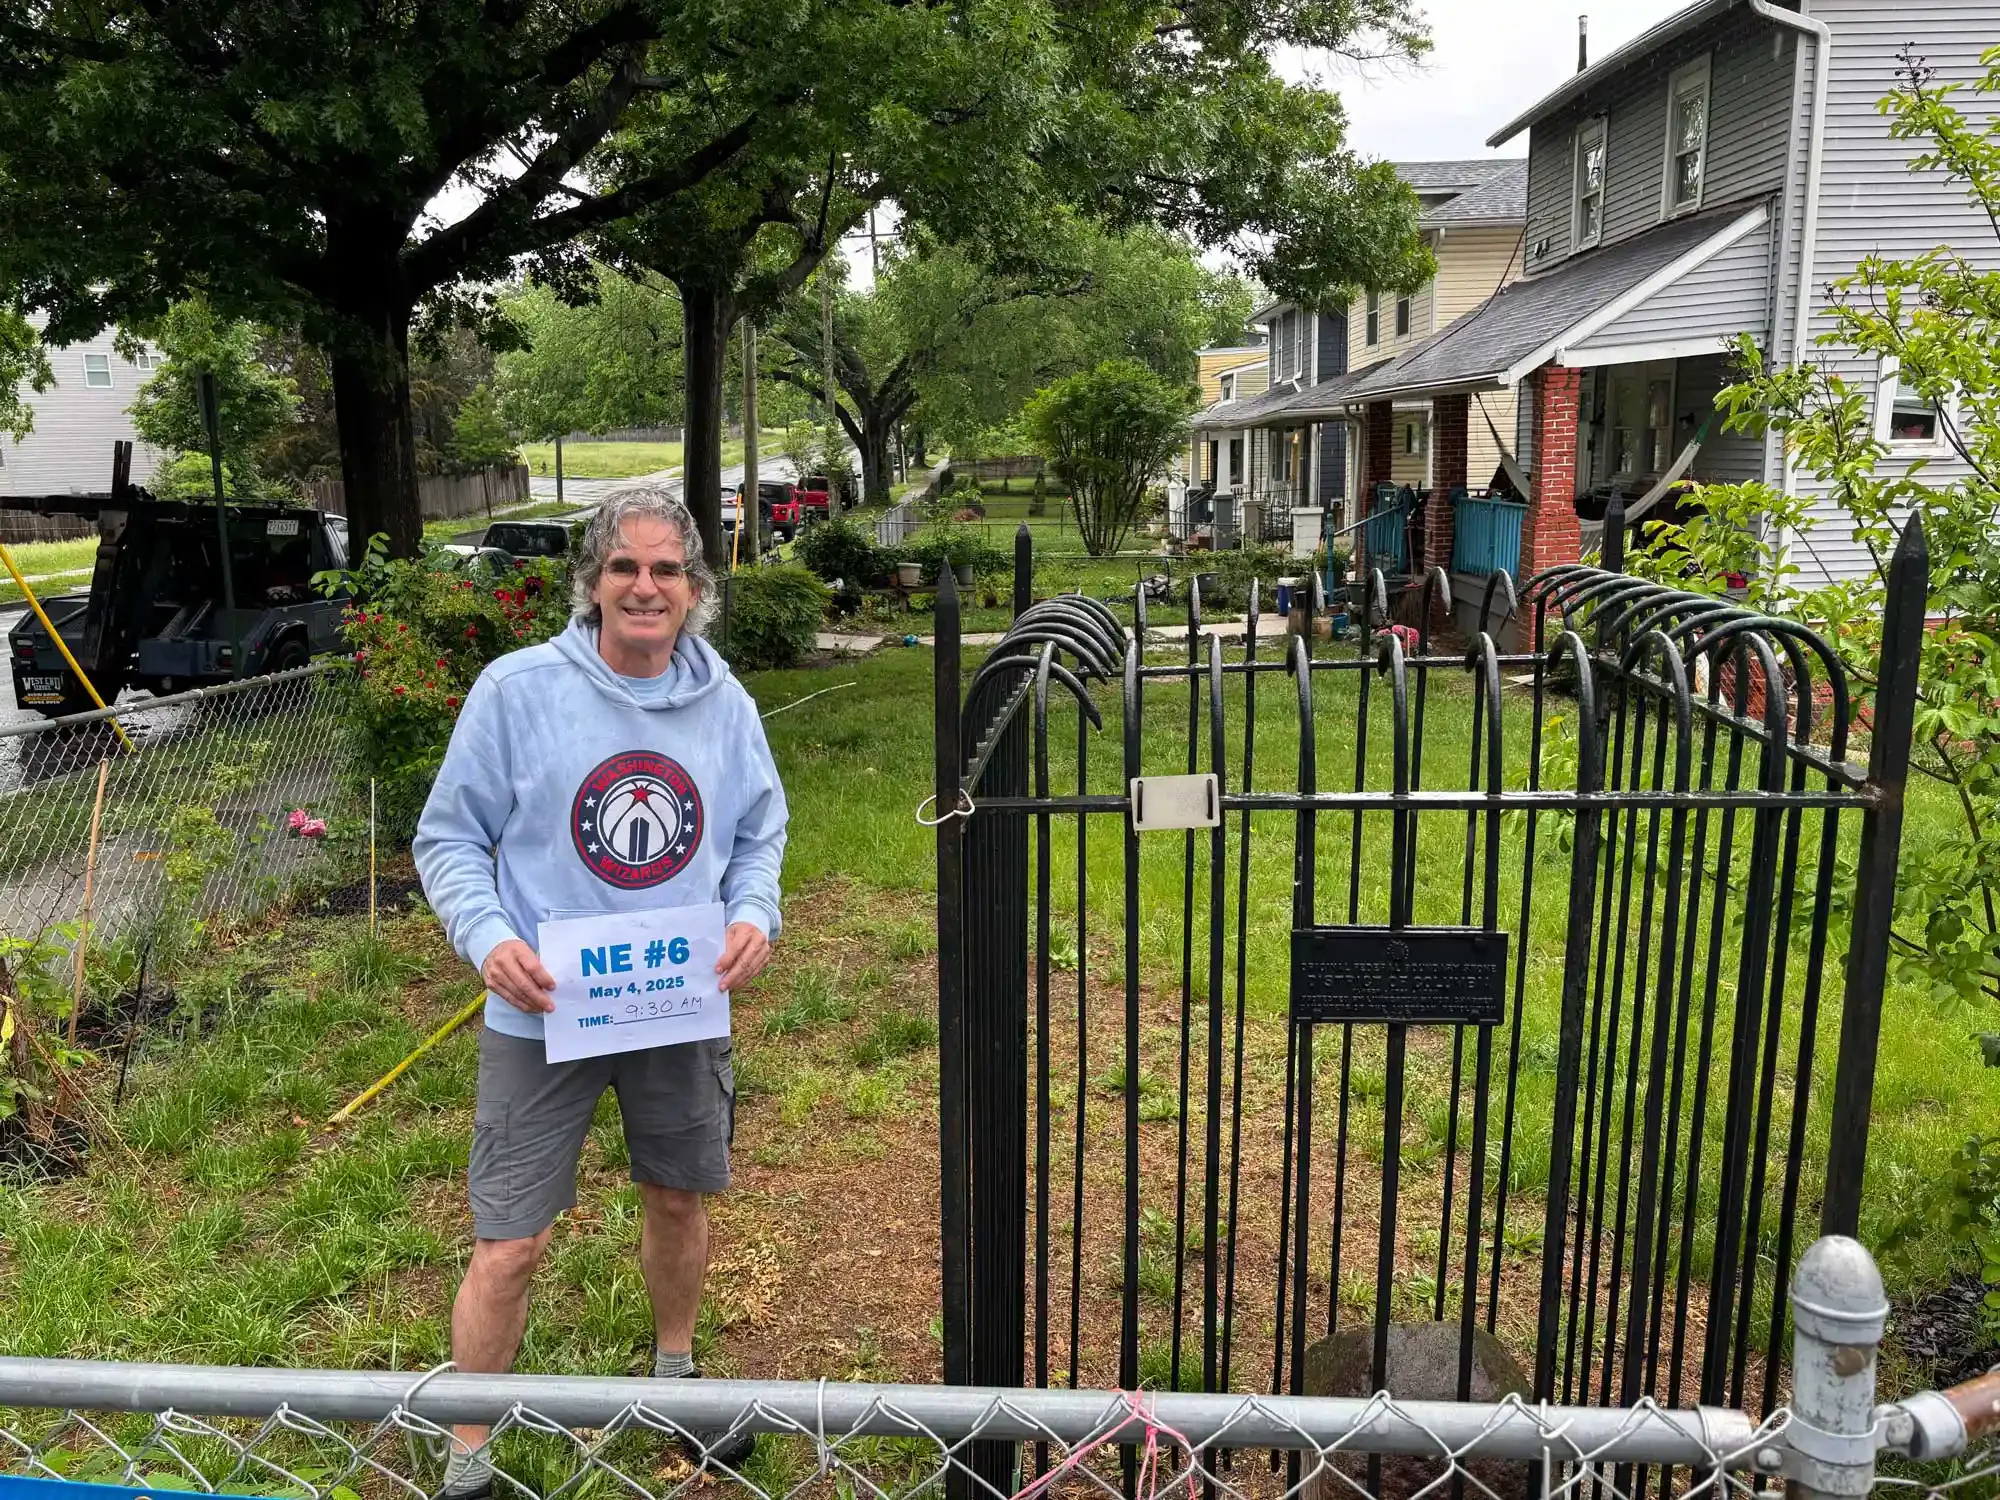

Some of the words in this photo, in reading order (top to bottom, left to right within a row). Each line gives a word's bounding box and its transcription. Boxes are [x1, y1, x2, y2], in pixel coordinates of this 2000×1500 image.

[592, 760, 689, 796] WASHINGTON
[600, 855, 673, 879] WIZARDS
[580, 943, 633, 977] NE
[644, 936, 690, 969] #6
[589, 984, 623, 999] May
[626, 982, 641, 995] 4,
[645, 976, 685, 992] 2025
[625, 999, 673, 1019] 9:30
[680, 996, 703, 1009] AM
[577, 1014, 614, 1029] TIME:
